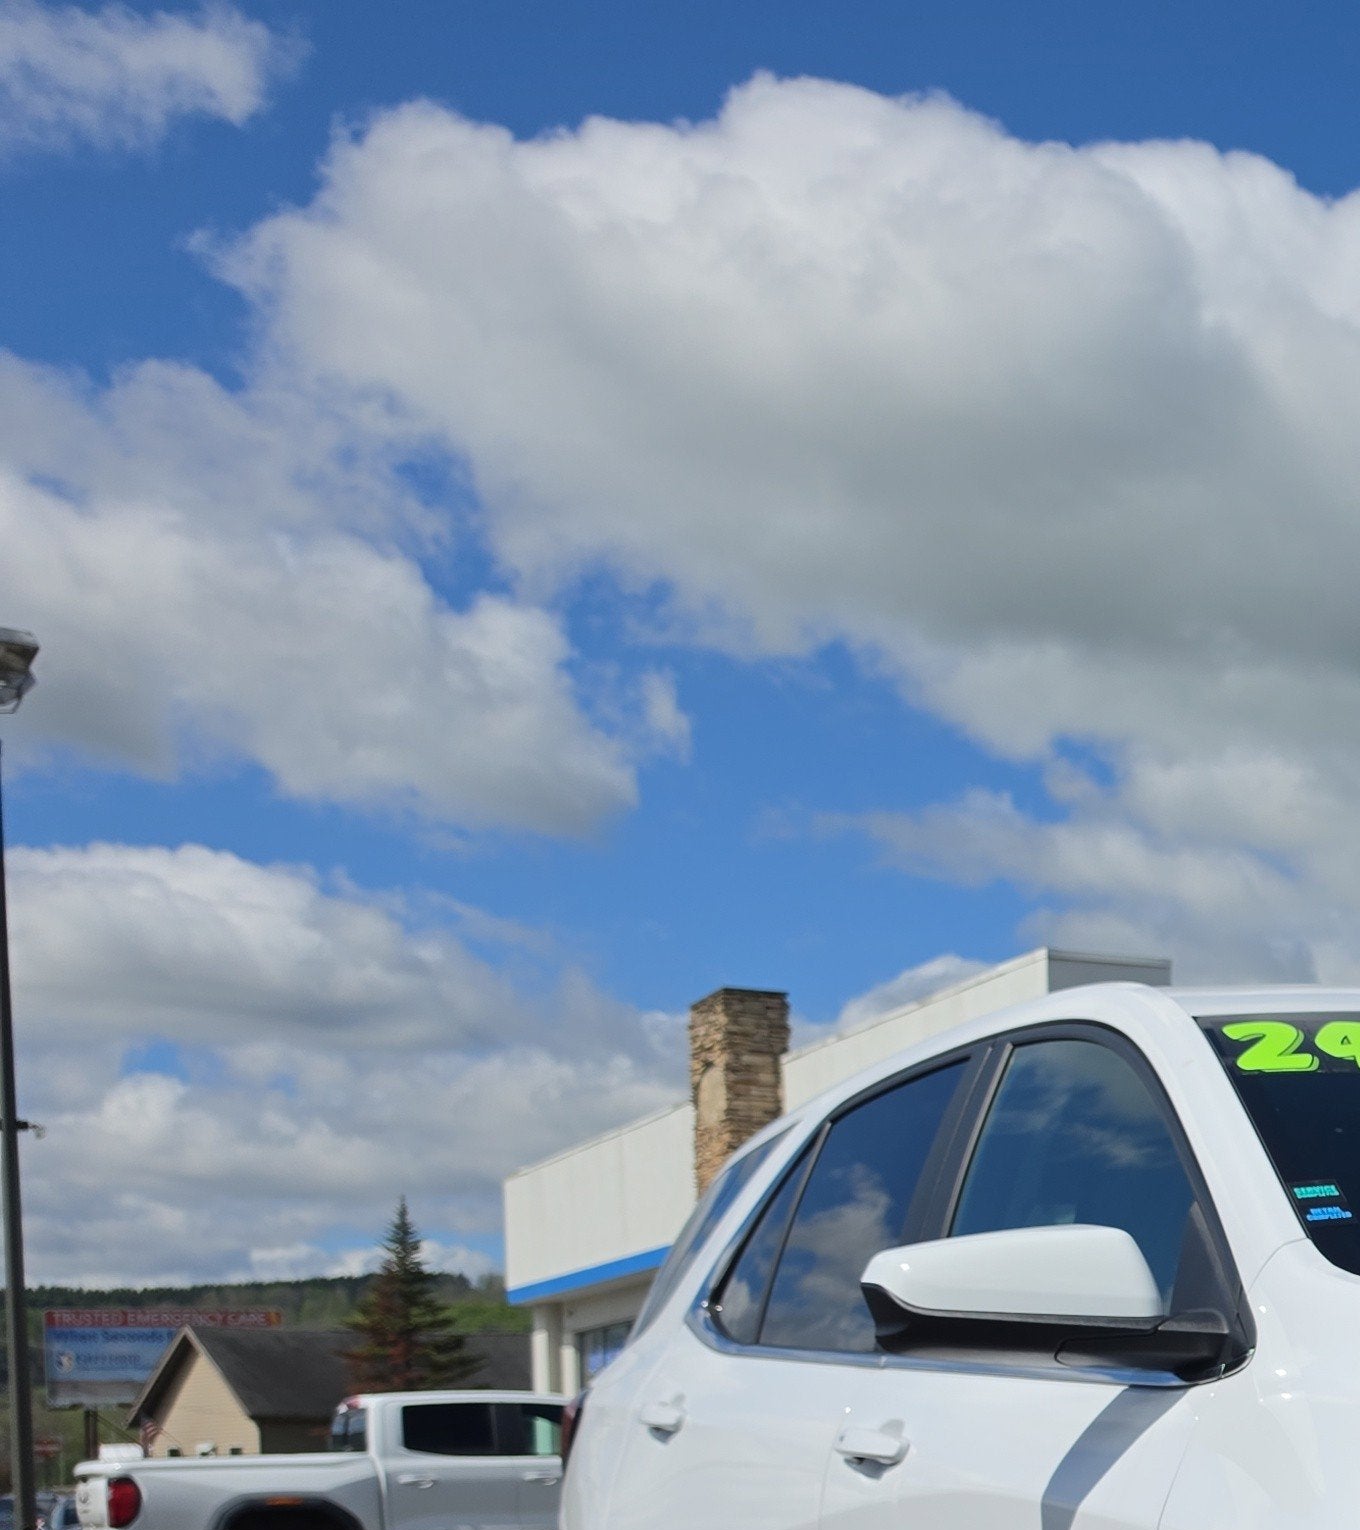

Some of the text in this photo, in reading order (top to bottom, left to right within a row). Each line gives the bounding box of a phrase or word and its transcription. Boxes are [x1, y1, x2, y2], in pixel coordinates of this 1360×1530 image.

[52, 1312, 268, 1327] TRUSTED EMERGENCY CARE
